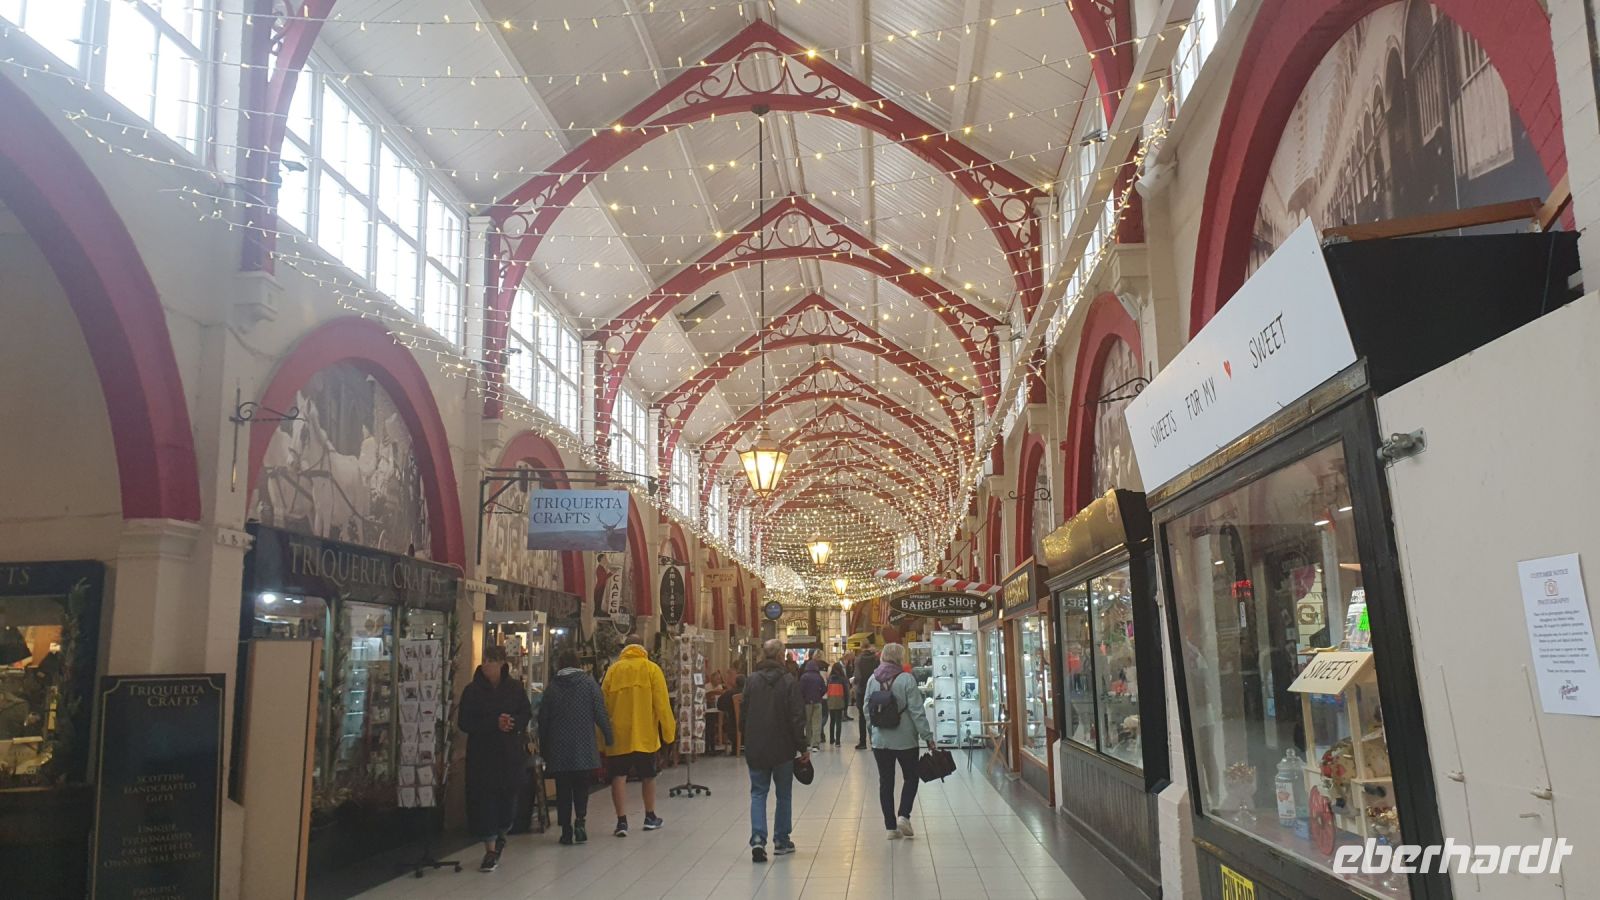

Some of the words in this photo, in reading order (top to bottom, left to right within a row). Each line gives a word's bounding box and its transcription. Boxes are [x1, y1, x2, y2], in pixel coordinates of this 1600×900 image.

[1150, 410, 1177, 448] SWEETS
[1185, 389, 1203, 420] FOR
[1202, 376, 1217, 407] MY
[1248, 311, 1287, 369] SWEET
[534, 496, 622, 511] TRIQUERTA
[533, 511, 591, 524] CRAFTS
[289, 541, 388, 587] TRIQUERTA
[392, 561, 442, 594] CRAFTS
[610, 574, 619, 608] CAFE
[901, 598, 946, 611] BARBER
[948, 597, 977, 608] SHOP
[1304, 660, 1357, 681] SWEETS
[129, 684, 205, 697] TRIQUERTA
[147, 696, 199, 707] CRAFTS
[123, 782, 197, 794] HANDCRAFTED
